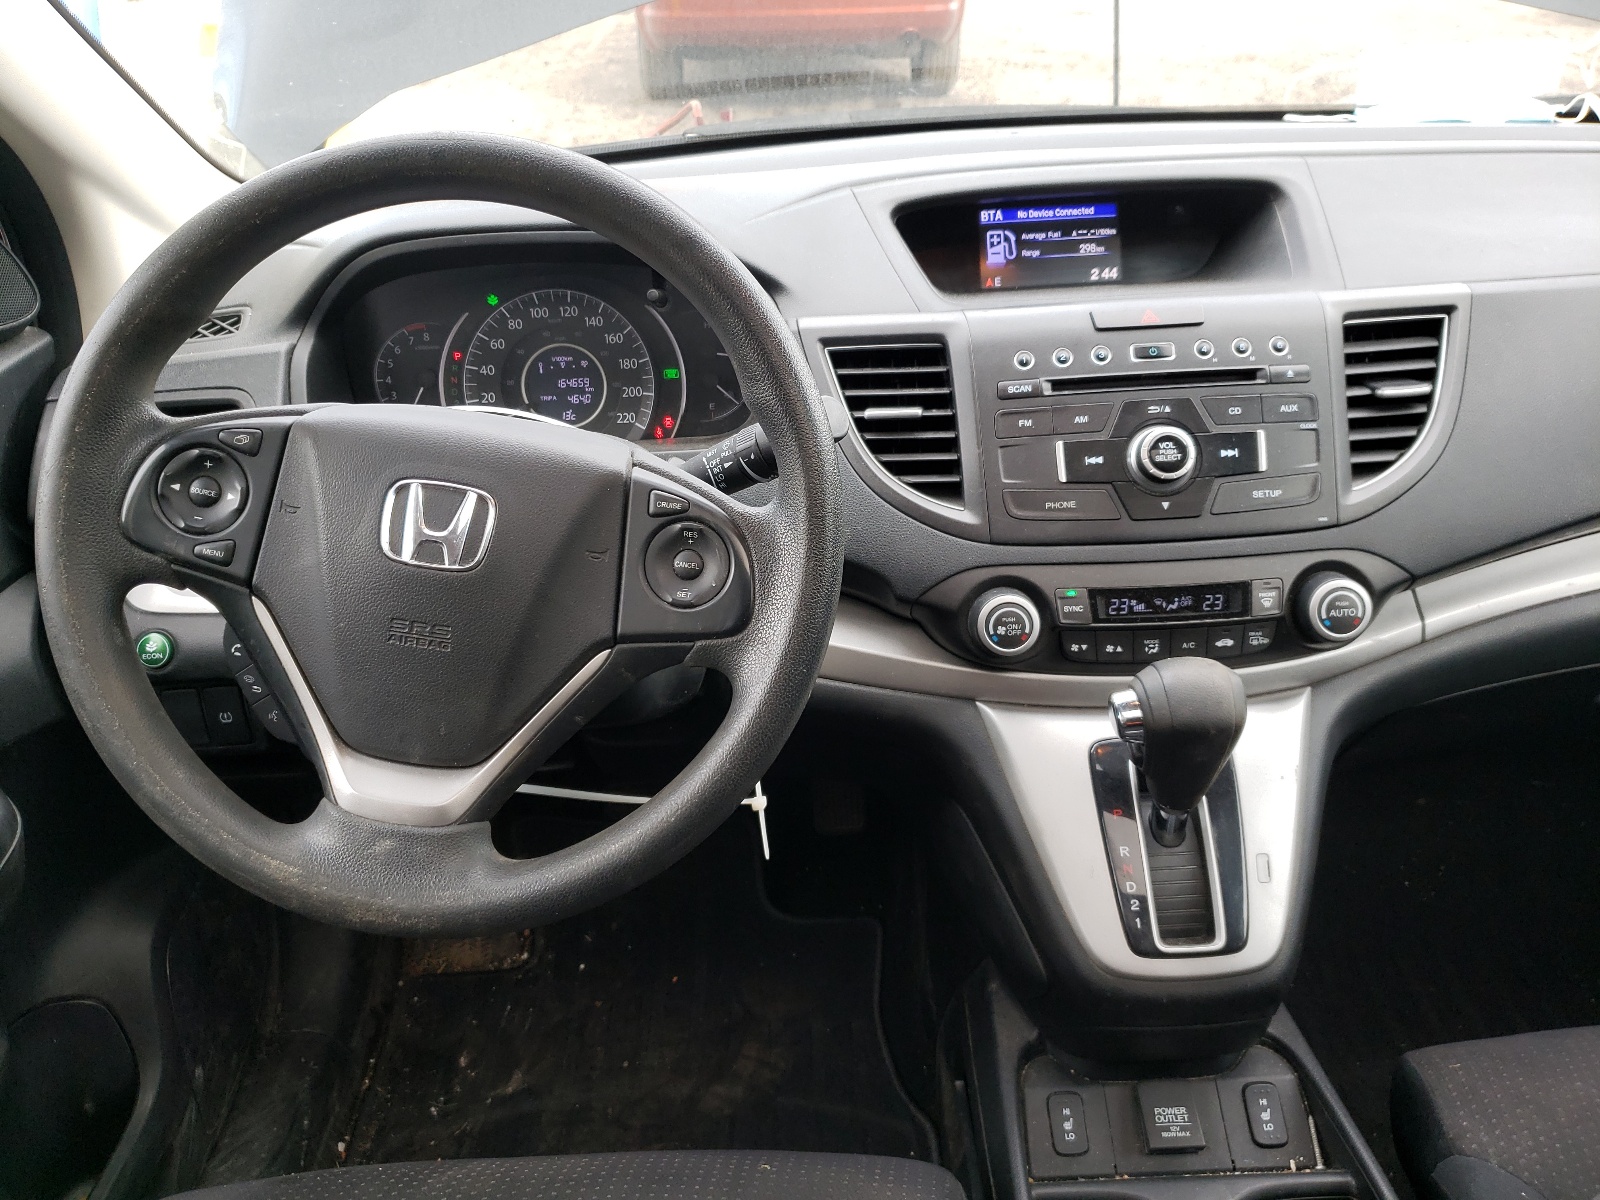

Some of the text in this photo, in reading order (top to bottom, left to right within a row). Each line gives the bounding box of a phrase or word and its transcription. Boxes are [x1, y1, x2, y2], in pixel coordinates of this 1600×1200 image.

[980, 210, 1003, 222] BTA
[1017, 206, 1095, 219] No Device Connected
[1021, 232, 1046, 241] Average
[1047, 230, 1062, 239] Fuel
[1021, 249, 1041, 258] Range
[530, 307, 549, 319] 100
[559, 305, 578, 317] 120
[508, 320, 523, 332] 80
[584, 316, 603, 327] 140
[409, 337, 414, 346] 7
[423, 332, 430, 341] 8
[604, 333, 624, 344] 160
[394, 345, 401, 354] 6
[490, 341, 505, 350] 60
[1200, 344, 1207, 353] 4
[454, 352, 461, 360] P
[1022, 355, 1027, 364] 1
[1059, 352, 1066, 361] 2
[1098, 350, 1105, 360] 3
[388, 360, 394, 368] 5
[618, 358, 638, 369] 180
[480, 365, 495, 377] 40
[385, 376, 392, 384] 4
[451, 377, 459, 385] N
[557, 378, 590, 389] 164659
[622, 386, 643, 398] 200
[1007, 384, 1031, 394] SCAN
[391, 391, 398, 401] 3
[481, 393, 496, 406] 20
[1228, 406, 1241, 415] CD
[1280, 403, 1298, 413] AUX
[616, 412, 637, 425] 220
[1018, 419, 1032, 428] FM
[1074, 414, 1087, 424] AM
[1158, 441, 1176, 450] VOL
[709, 458, 721, 468] OFF
[1155, 454, 1181, 462] SELECT
[715, 473, 725, 482] LO
[190, 485, 219, 499] SOURCE
[1252, 489, 1282, 499] SETUP
[656, 500, 683, 510] CRUISE
[1045, 500, 1076, 510] PHONE
[683, 530, 698, 539] RES
[202, 547, 224, 558] MENU
[674, 560, 699, 570] CANCEL
[676, 590, 691, 599] SET
[1108, 598, 1128, 615] 23
[1203, 594, 1223, 611] 23
[1063, 604, 1084, 613] SYNC
[1329, 607, 1356, 618] AUTO
[1007, 623, 1022, 631] ON/
[1007, 629, 1022, 637] OFF
[1182, 641, 1196, 649] A/C
[1113, 809, 1122, 820] P
[1119, 846, 1130, 857] R
[1122, 864, 1133, 874] N
[1125, 881, 1137, 893] D
[1130, 899, 1140, 911] 2
[1135, 917, 1141, 928] 1
[1258, 1098, 1268, 1106] HI
[1154, 1106, 1187, 1115] POWER
[1155, 1114, 1189, 1123] OUTLET
[1263, 1123, 1274, 1131] LO
[1064, 1132, 1075, 1140] LO
